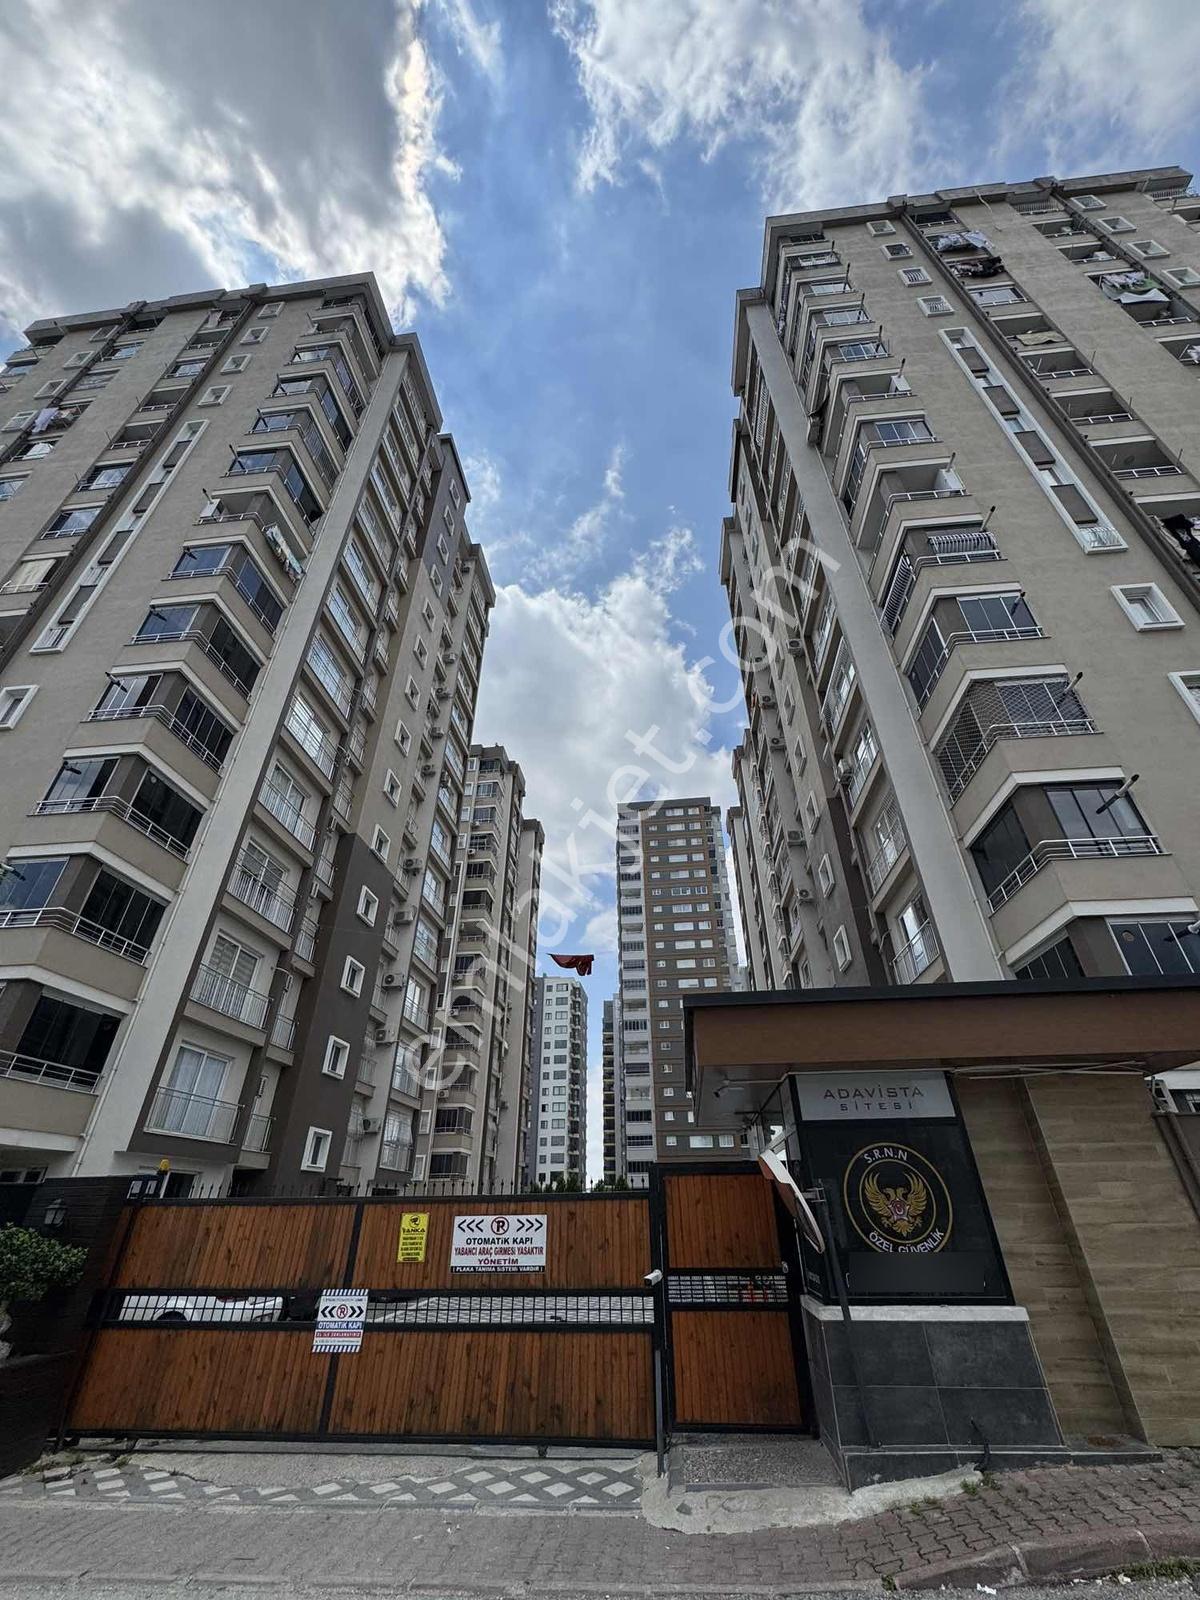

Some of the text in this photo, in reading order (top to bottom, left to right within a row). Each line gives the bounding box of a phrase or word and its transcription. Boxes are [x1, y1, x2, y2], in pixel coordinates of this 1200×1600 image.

[823, 1084, 924, 1099] ADAVİSTA
[466, 1236, 533, 1246] OTOMATİK KAPI
[869, 1230, 894, 1253] ÖZEL
[454, 1246, 478, 1256] YABANCI
[517, 1246, 544, 1255] YASAKTIR
[478, 1257, 519, 1265] YÖNETİM
[318, 1321, 363, 1329] OTOMATİK KAPI
